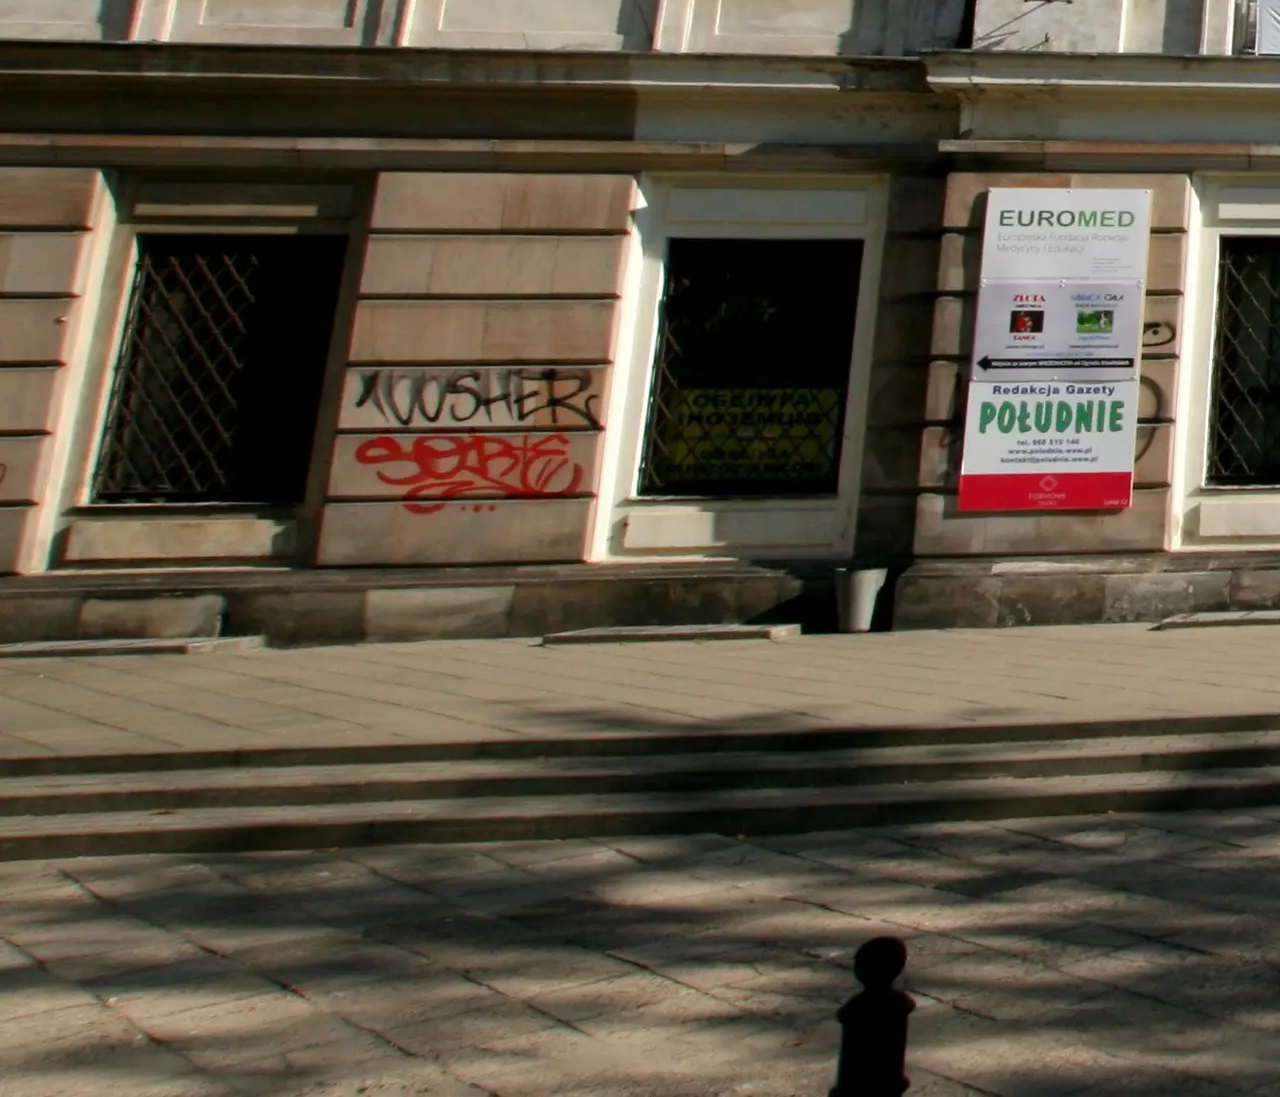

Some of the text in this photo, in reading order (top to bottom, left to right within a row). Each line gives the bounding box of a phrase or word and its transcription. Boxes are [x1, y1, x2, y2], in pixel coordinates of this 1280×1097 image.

[999, 210, 1135, 227] EUROMED
[993, 385, 1115, 397] Redakcja Gazety
[979, 400, 1125, 434] POŁUDNIE
